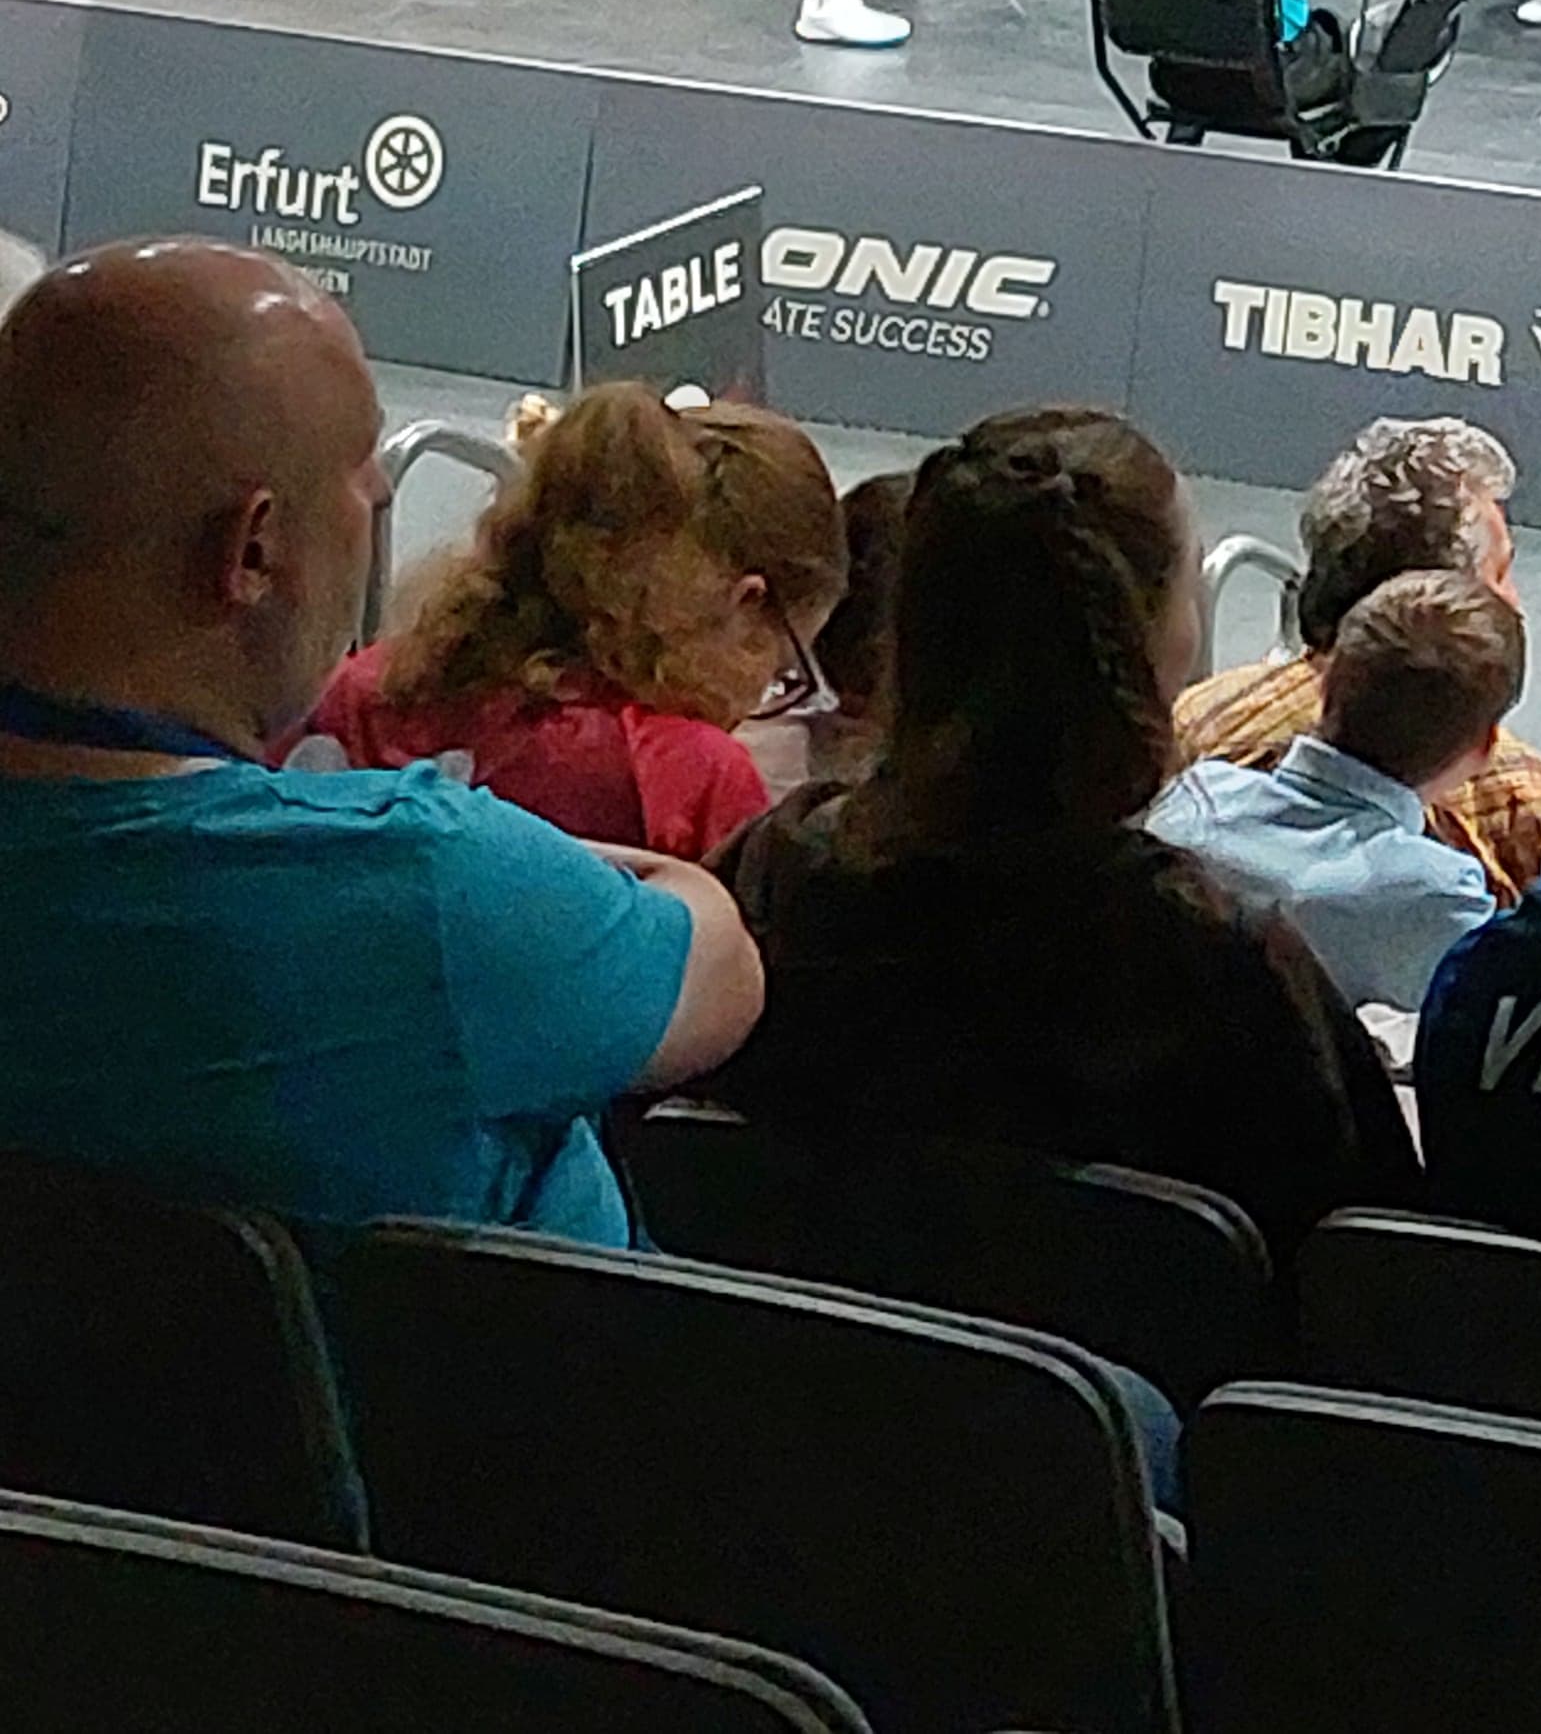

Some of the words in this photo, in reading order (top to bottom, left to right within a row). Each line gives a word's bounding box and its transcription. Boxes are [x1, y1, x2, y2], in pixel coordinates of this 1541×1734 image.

[198, 141, 361, 225] Erfurt
[604, 242, 742, 347] TABLE
[760, 225, 1057, 318] ONIC
[828, 308, 993, 361] SUCCESS
[1213, 279, 1507, 387] TIBHAR
